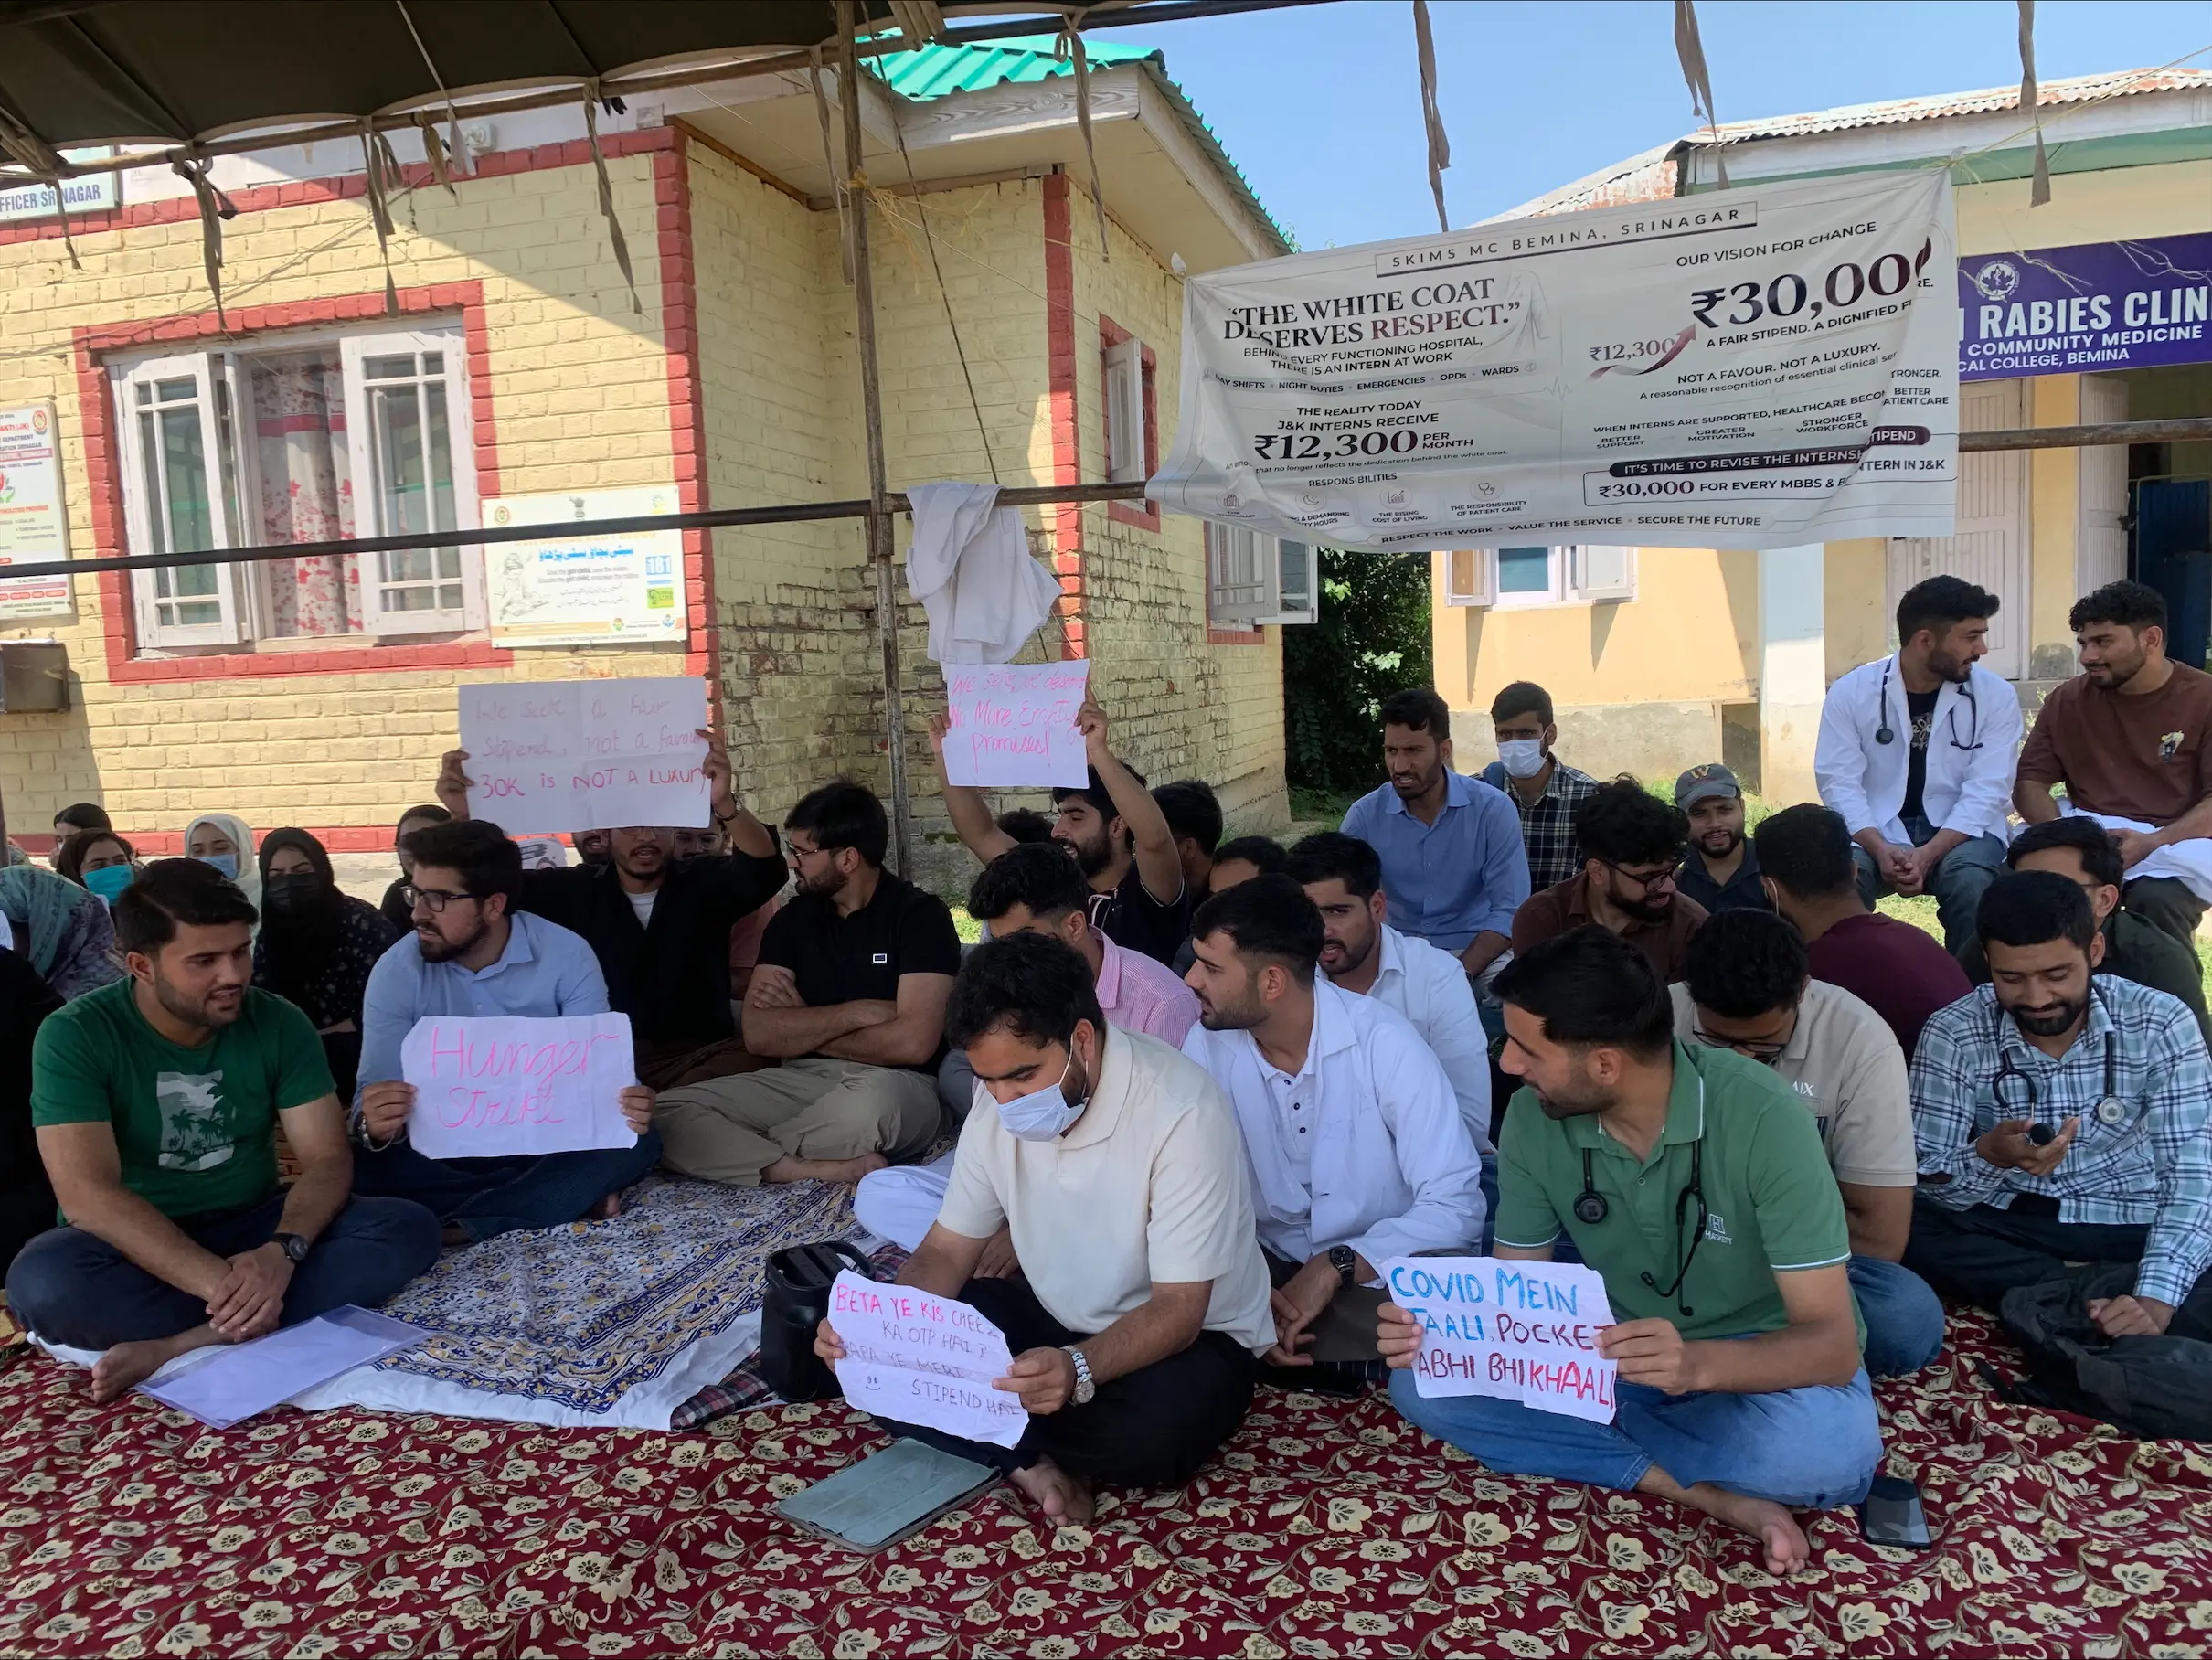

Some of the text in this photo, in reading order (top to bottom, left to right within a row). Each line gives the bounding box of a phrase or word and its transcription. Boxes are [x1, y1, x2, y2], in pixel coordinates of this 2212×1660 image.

[40, 184, 101, 208] SRNAGAR
[1392, 209, 1739, 267] SKIMS MC BEMINA, SRINAGAR
[1675, 221, 1877, 267] OUR VISION FOR CHANGE
[1303, 291, 1404, 321] WHITE
[1411, 277, 1495, 308] COAT
[1979, 294, 2111, 340] RABIES
[2123, 285, 2212, 327] CLIN
[1706, 339, 1716, 348] A
[1719, 334, 1748, 346] FAIR
[1751, 324, 1811, 341] STIPEND.
[1814, 321, 1824, 331] A
[1828, 304, 1898, 329] DIGNIFIED
[1291, 353, 1328, 365] EVERY
[1331, 344, 1416, 361] FUNCTIONING
[1419, 336, 1484, 352] HOSPITAL,
[1967, 325, 2203, 357] COMMUNITY MEDICINE
[1311, 367, 1322, 376] IS
[1324, 364, 1342, 376] AN
[1345, 360, 1390, 372] INTERN
[1394, 356, 1410, 367] AT
[1412, 351, 1452, 365] WORK
[1677, 342, 1881, 384] NOT A FAVOUR. NOT A LUXURY.
[1958, 347, 2130, 373] CAL COLLEGE, BEMINA
[1232, 379, 1265, 389] SHIFTS
[1278, 381, 1309, 390] NIGHT
[1310, 384, 1344, 393] DUTIES
[1356, 377, 1426, 391] EMERGENCIES
[1440, 372, 1467, 381] OPDs
[1481, 366, 1520, 377] WARDS
[1639, 356, 1879, 400] A reasonable recognition of essential clinical
[1894, 387, 1931, 396] BETTER
[1296, 399, 1422, 417] THE REALITY TODAY
[1920, 396, 1950, 406] CARE
[1277, 412, 1440, 431] J&K INTERNS RECEIVE
[1593, 398, 1847, 433] WHEN INTERNS ARE SUPPORTED, HEALTHCARE
[1796, 420, 1869, 433] WORKFORCE
[1802, 411, 1863, 427] STRONGER
[1422, 431, 1451, 442] PER
[1422, 439, 1474, 450] MONTH
[1596, 440, 1645, 449] SUPPORT
[1601, 434, 1641, 443] BETTER
[1687, 431, 1756, 442] MOTIVATION
[1696, 426, 1747, 436] GREATER
[1253, 429, 1419, 462] ₹12,300
[1651, 462, 1685, 473] TIME
[1687, 460, 1707, 470] TO
[1710, 456, 1760, 469] REVISE
[1762, 453, 1792, 465] THE
[1870, 430, 1917, 443] TIPEND
[1255, 465, 1273, 474] that
[1286, 463, 1313, 473] longer
[1315, 461, 1346, 470] reflects
[1364, 457, 1409, 465] dedication
[1411, 453, 1442, 463] behind
[1308, 472, 1398, 487] RESPONSIBILITIES
[1599, 459, 1946, 498] ₹30,000 FOR EVERY MBBS & IN J&K
[1381, 531, 1430, 544] RESPECT
[1457, 527, 1494, 536] WORK
[1507, 522, 1546, 531] VALUE
[1547, 519, 1571, 528] THE
[1573, 516, 1623, 527] SERVICE
[1637, 516, 1685, 526] SECURE
[1686, 516, 1712, 525] THE
[1714, 516, 1762, 527] FUTURE
[572, 767, 620, 789] NOT
[627, 768, 639, 785] A
[431, 1027, 620, 1093] Hunger
[435, 1082, 566, 1128] Strike
[835, 1283, 883, 1316] BETA
[890, 1296, 914, 1321] YE
[1390, 1266, 1578, 1317] COVID MEIN
[882, 1320, 904, 1342] KA
[908, 1327, 936, 1346] OTP
[942, 1333, 973, 1354] HAI
[1418, 1349, 1616, 1410] ABHI BHI KHAALI
[910, 1378, 1021, 1416] STIPEND HAI
